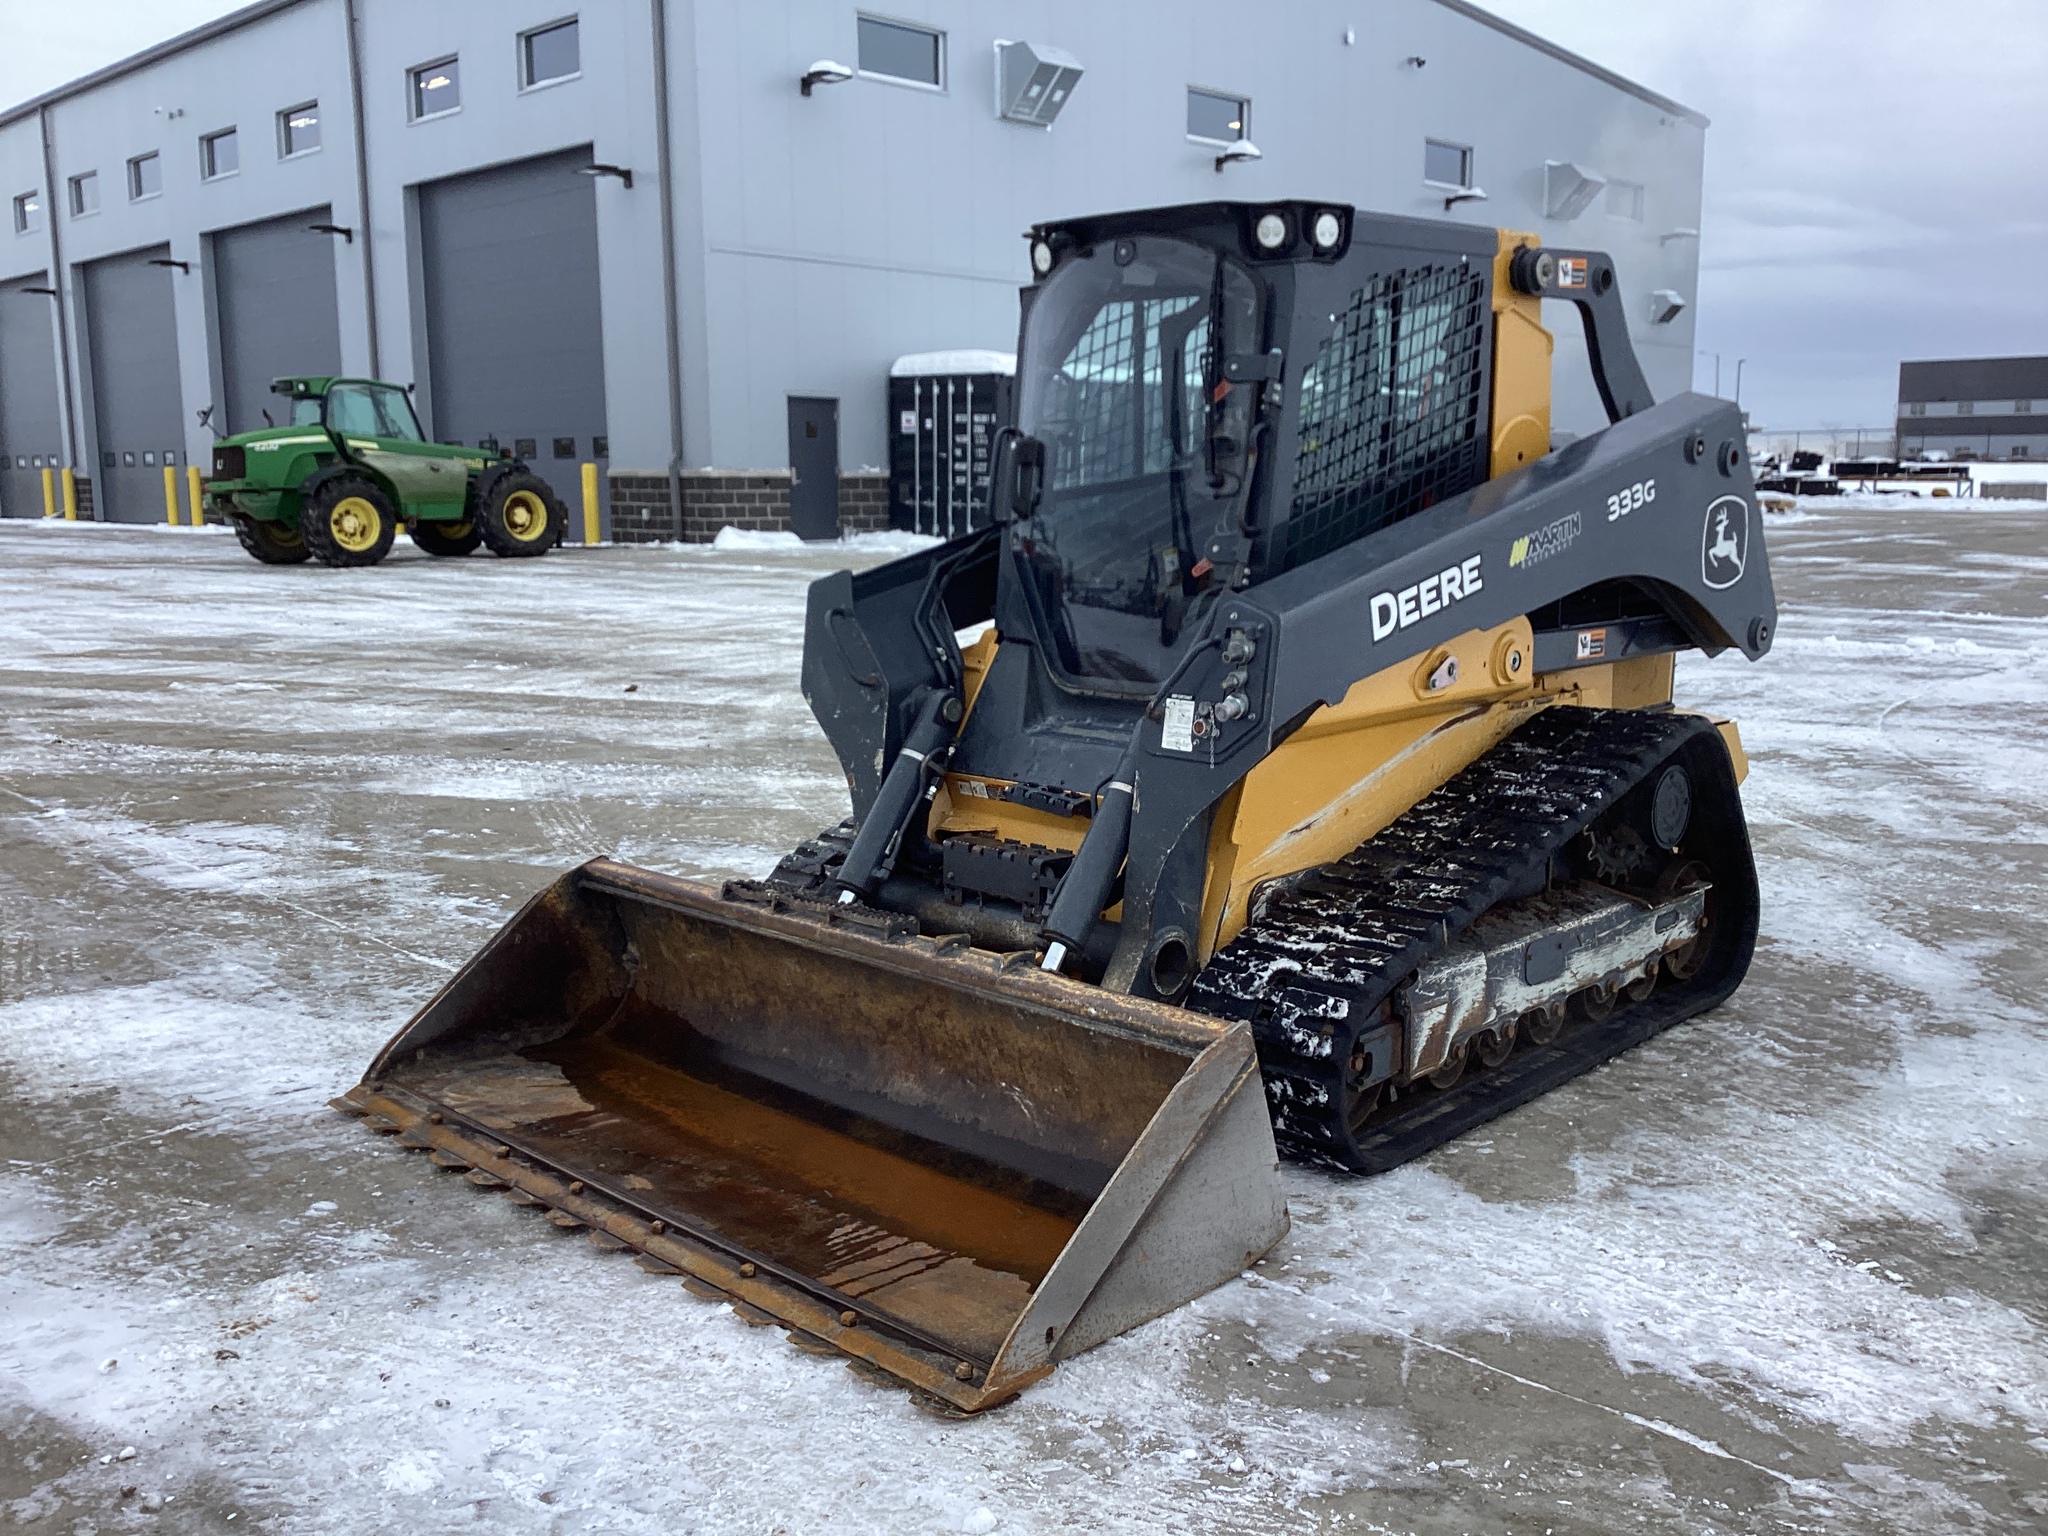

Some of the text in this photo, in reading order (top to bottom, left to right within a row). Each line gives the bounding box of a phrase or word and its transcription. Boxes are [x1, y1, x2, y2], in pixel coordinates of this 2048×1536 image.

[1607, 478, 1656, 522] 333G
[1526, 511, 1582, 559] MARTIN
[1370, 554, 1483, 642] DEERE
